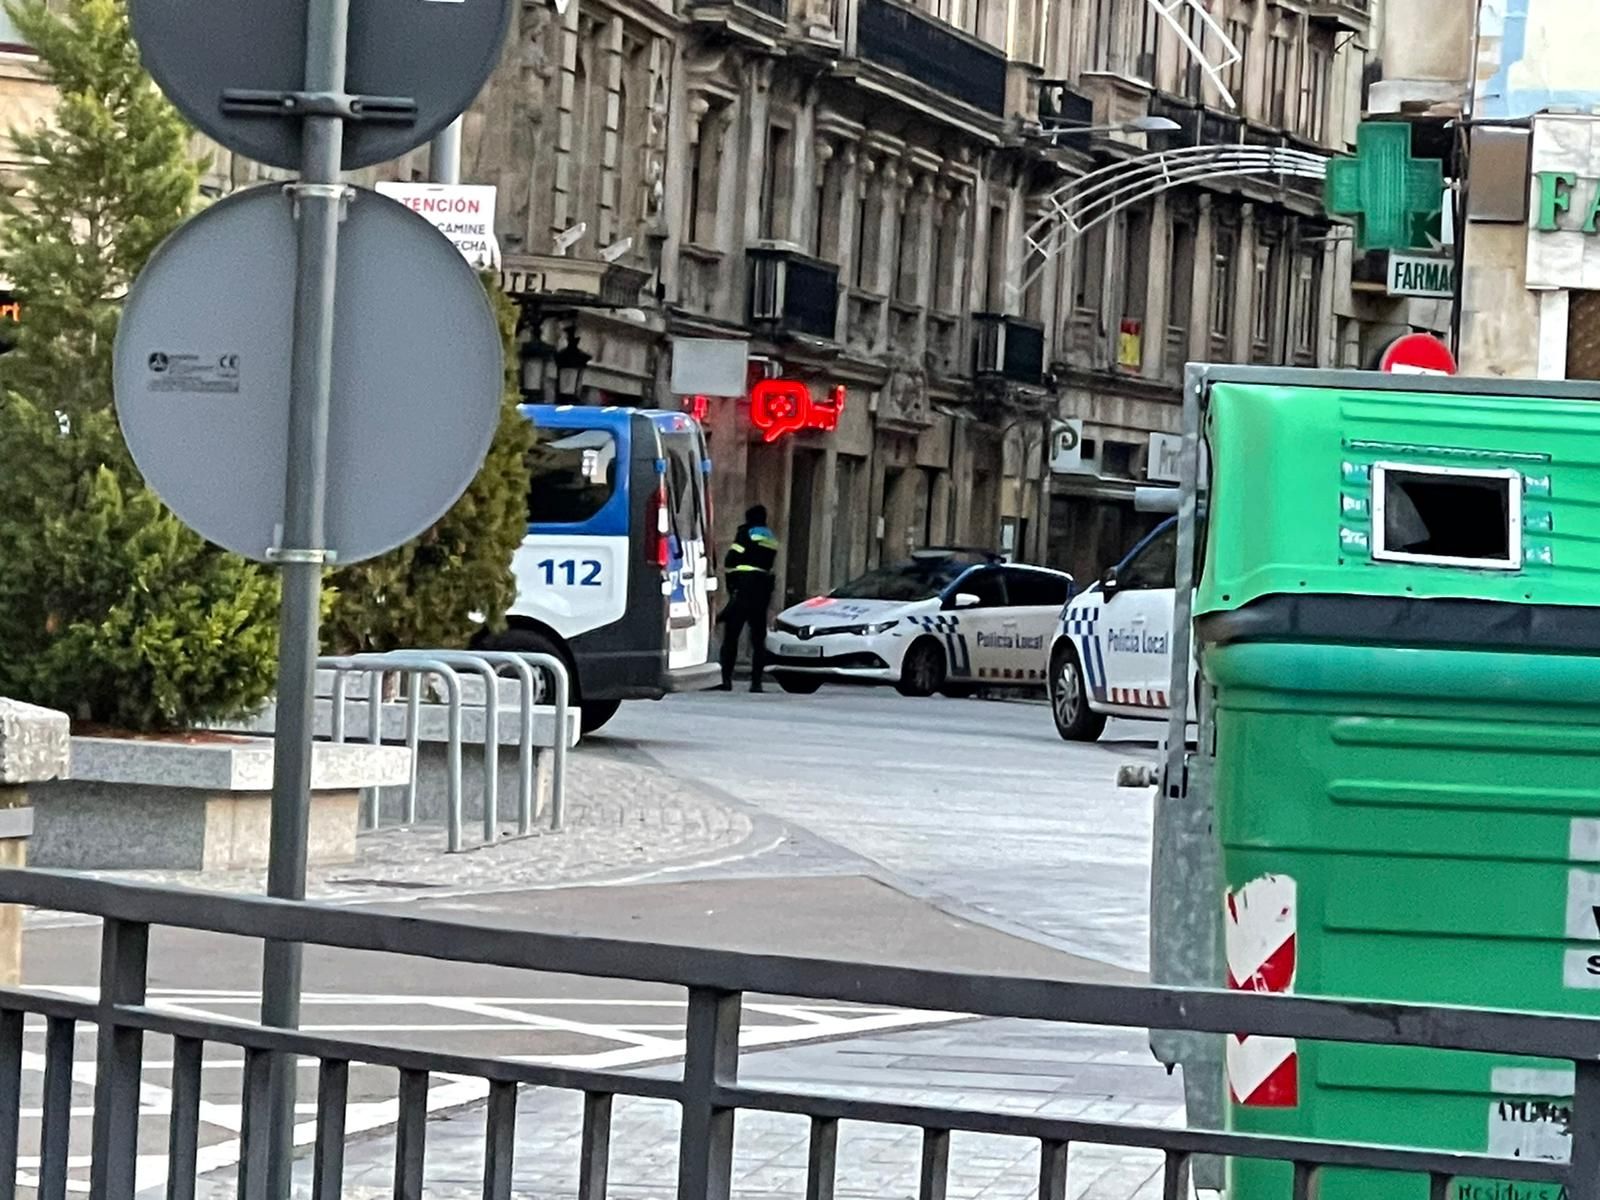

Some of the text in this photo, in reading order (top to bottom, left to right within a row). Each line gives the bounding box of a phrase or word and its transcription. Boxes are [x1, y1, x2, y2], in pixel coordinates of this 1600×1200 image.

[401, 197, 480, 213] TENCIÓN
[454, 240, 488, 252] ECHA
[1395, 262, 1453, 291] FARMA
[537, 559, 603, 586] 112
[1015, 632, 1044, 650] Local
[1142, 629, 1169, 654] Local
